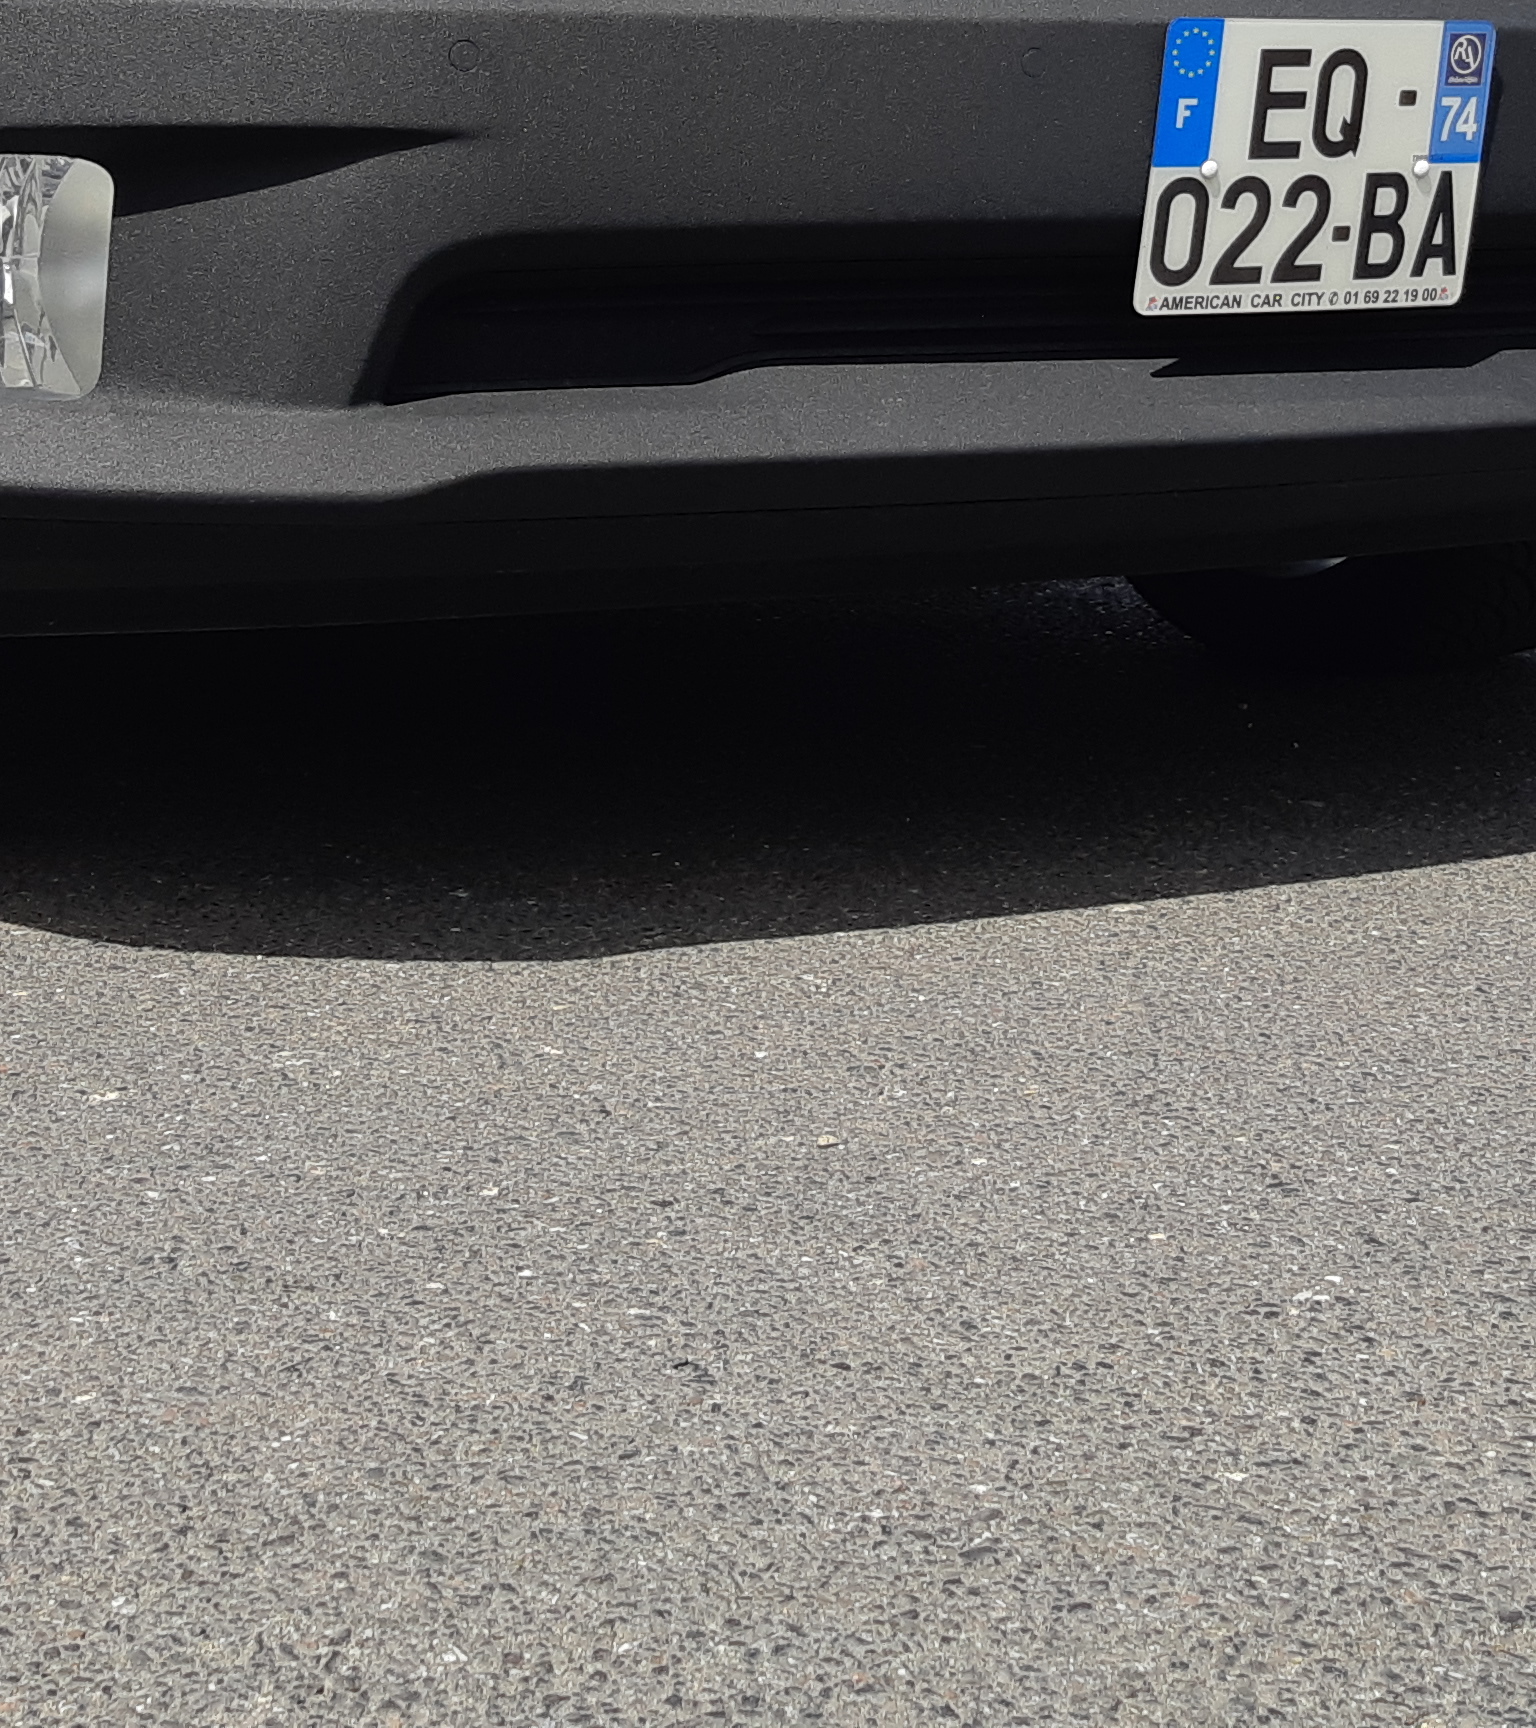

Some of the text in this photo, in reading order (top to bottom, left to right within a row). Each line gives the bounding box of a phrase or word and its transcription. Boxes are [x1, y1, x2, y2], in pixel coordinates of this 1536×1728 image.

[1175, 98, 1199, 129] F
[1440, 96, 1478, 142] 74
[1149, 170, 1457, 287] 022-BA
[1159, 287, 1438, 311] AMERICAN CAR CITY 01 69 22 19 00
